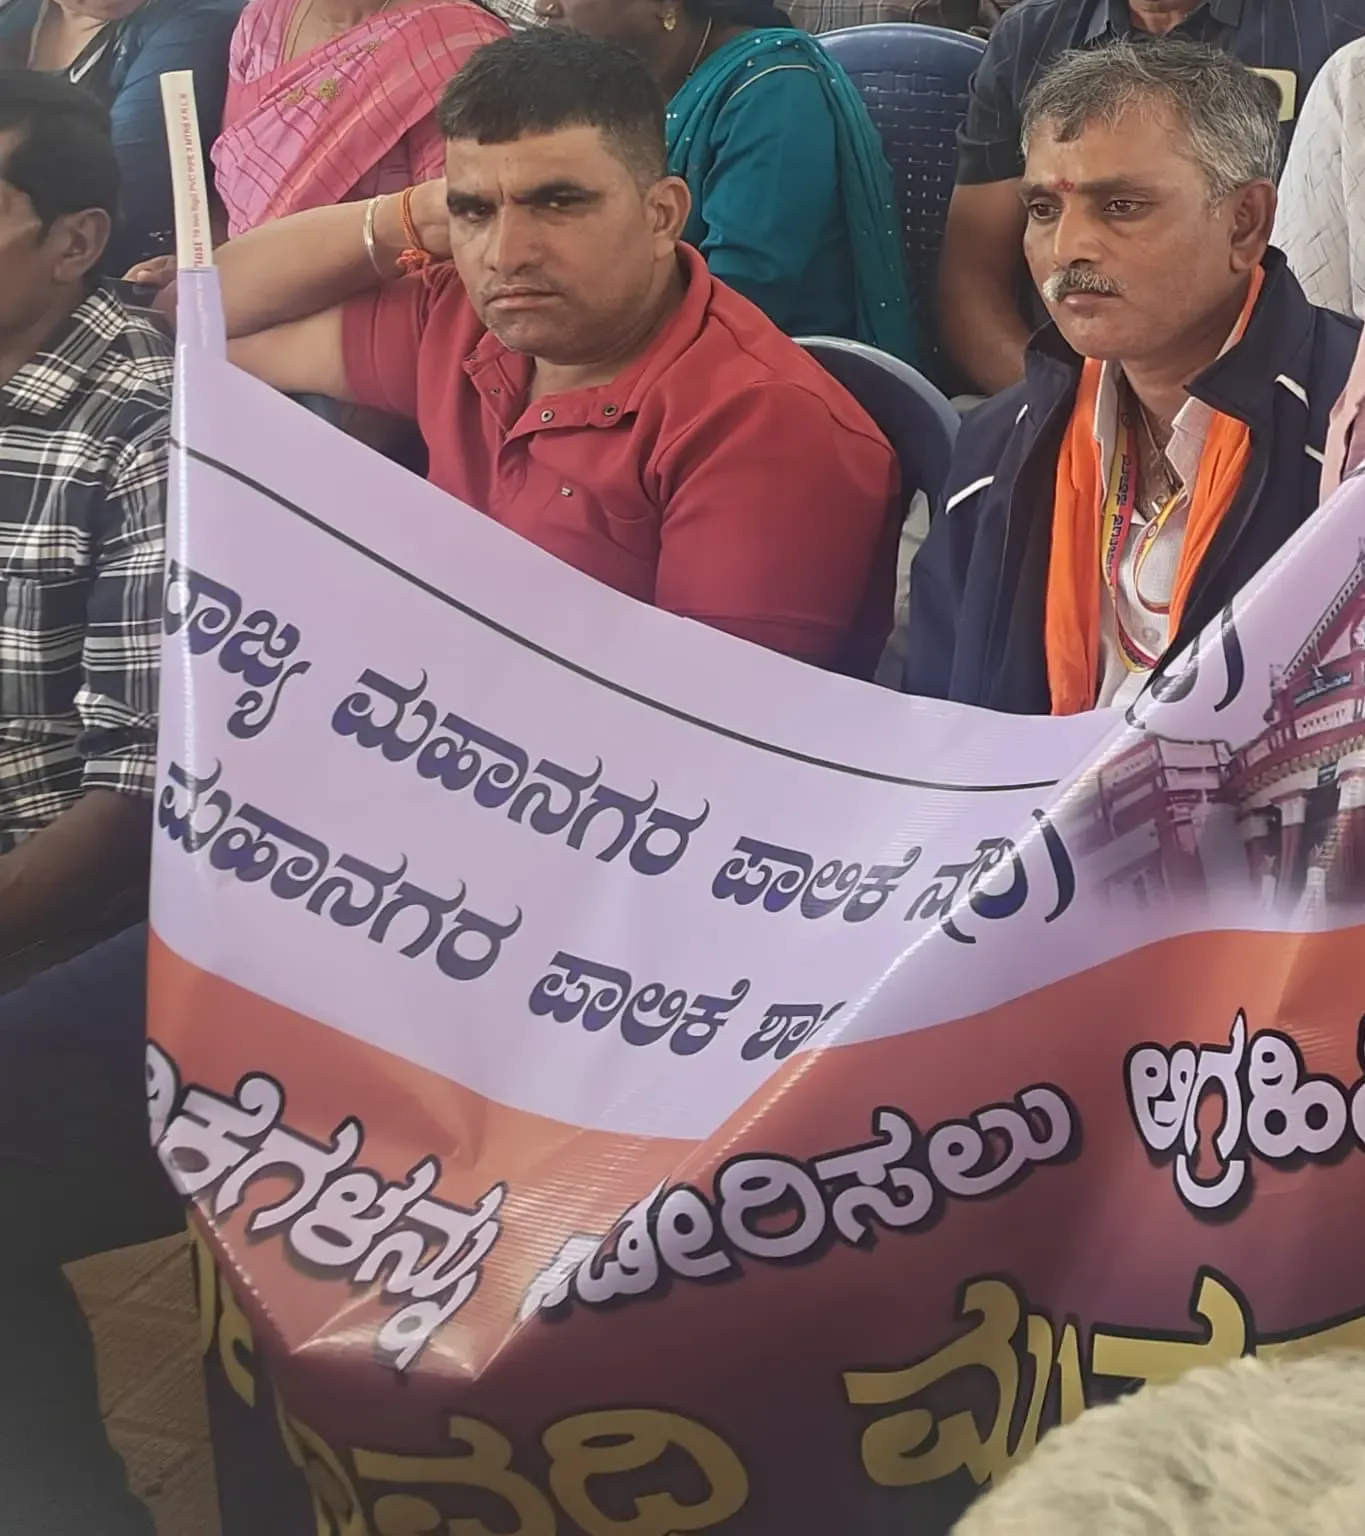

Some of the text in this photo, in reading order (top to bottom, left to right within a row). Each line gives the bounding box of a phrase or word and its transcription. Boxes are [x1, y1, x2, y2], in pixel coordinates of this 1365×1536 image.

[331, 667, 710, 876] ಮಹಾನಗರ
[158, 759, 522, 981] ಮಹಾನಗರ
[528, 951, 752, 1056] ಪಾಲಿಕೆ
